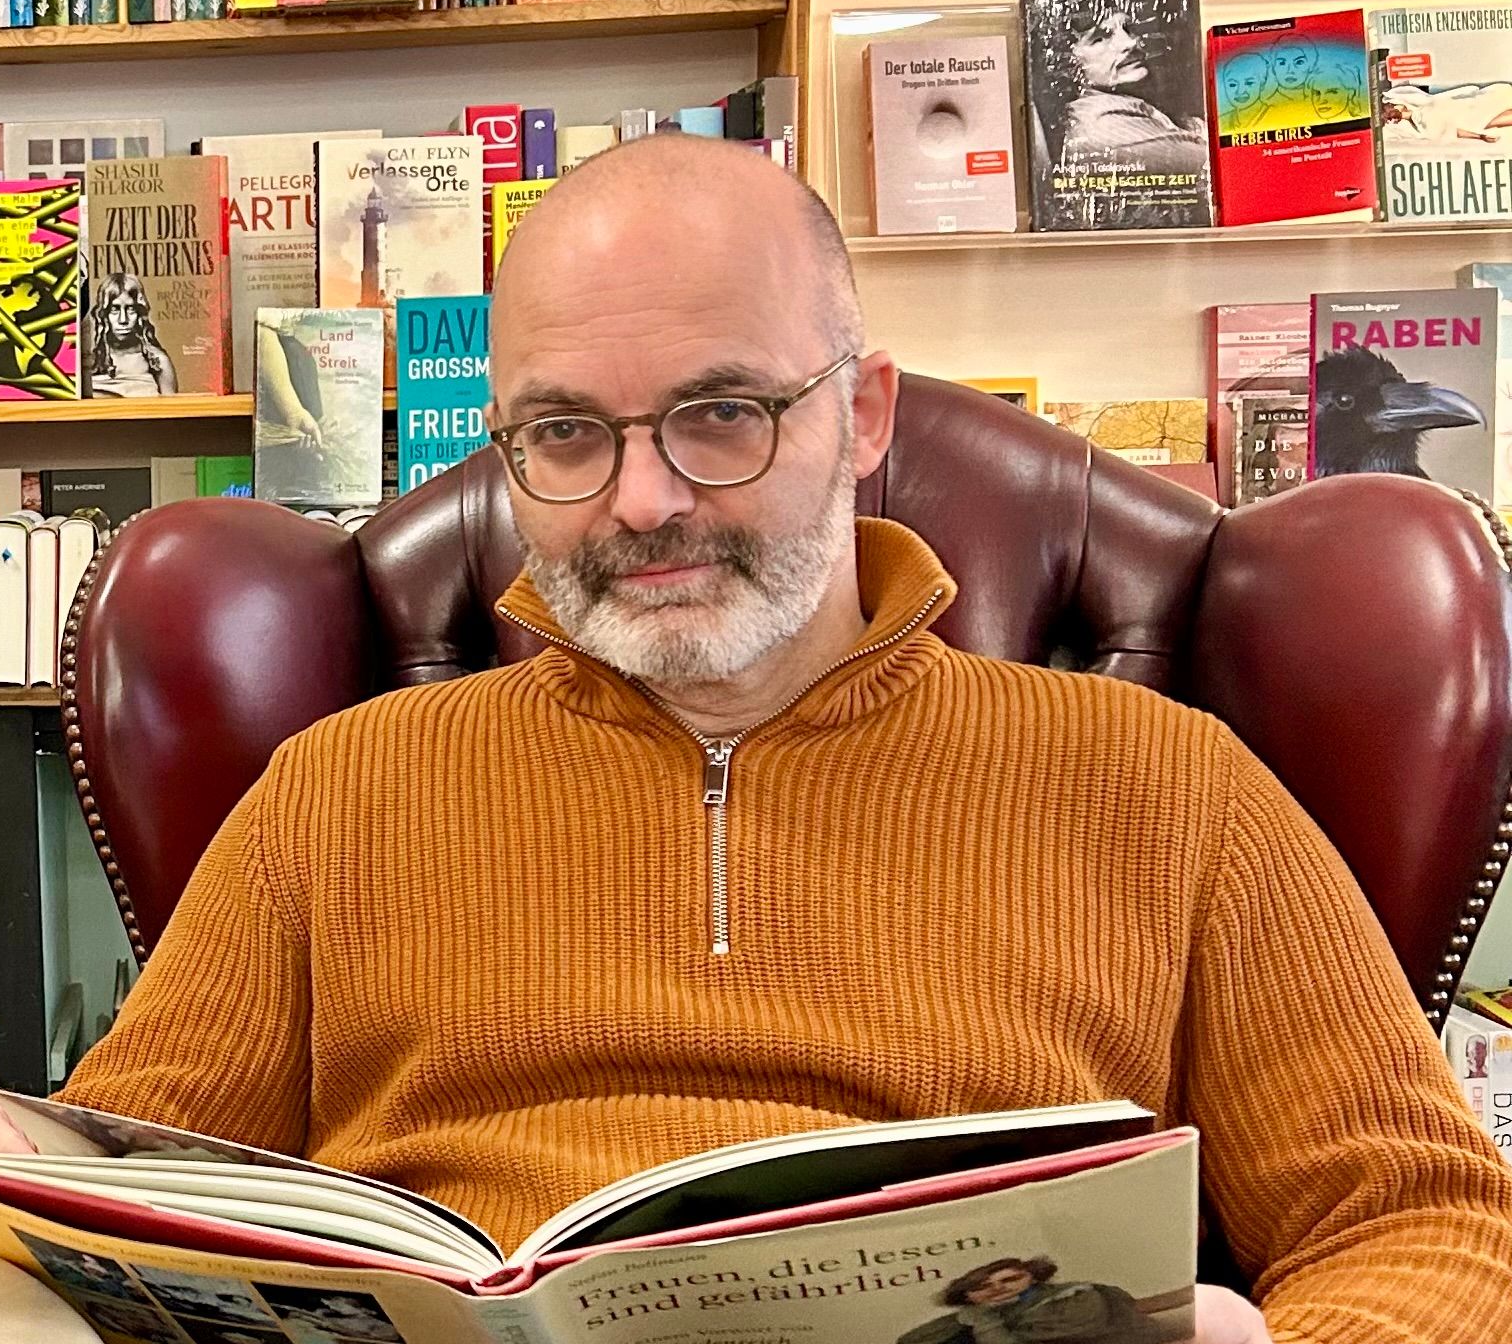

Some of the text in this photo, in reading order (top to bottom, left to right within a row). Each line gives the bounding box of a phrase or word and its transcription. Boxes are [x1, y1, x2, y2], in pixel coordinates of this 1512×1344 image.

[1381, 13, 1433, 35] THERESIA
[884, 55, 996, 76] Der totale Rausch
[1230, 125, 1313, 146] REBEL GIRLS
[426, 146, 471, 160] FLYN
[93, 163, 160, 180] SHASHI
[347, 163, 458, 179] Verlassene
[1167, 172, 1198, 187] ZEIT
[426, 176, 470, 193] Orte
[12, 193, 39, 204] Malm
[11, 220, 36, 231] eine
[105, 204, 200, 242] ZEIT DER
[92, 240, 214, 280] FINSTERNIS
[318, 329, 354, 342] Land
[1331, 317, 1482, 350] RABEN
[318, 356, 358, 370] Streit
[409, 440, 459, 459] IST DIE
[1254, 438, 1293, 452] DIE
[578, 1258, 841, 1313] Frauen, die
[586, 1263, 944, 1329] sind gefährlich
